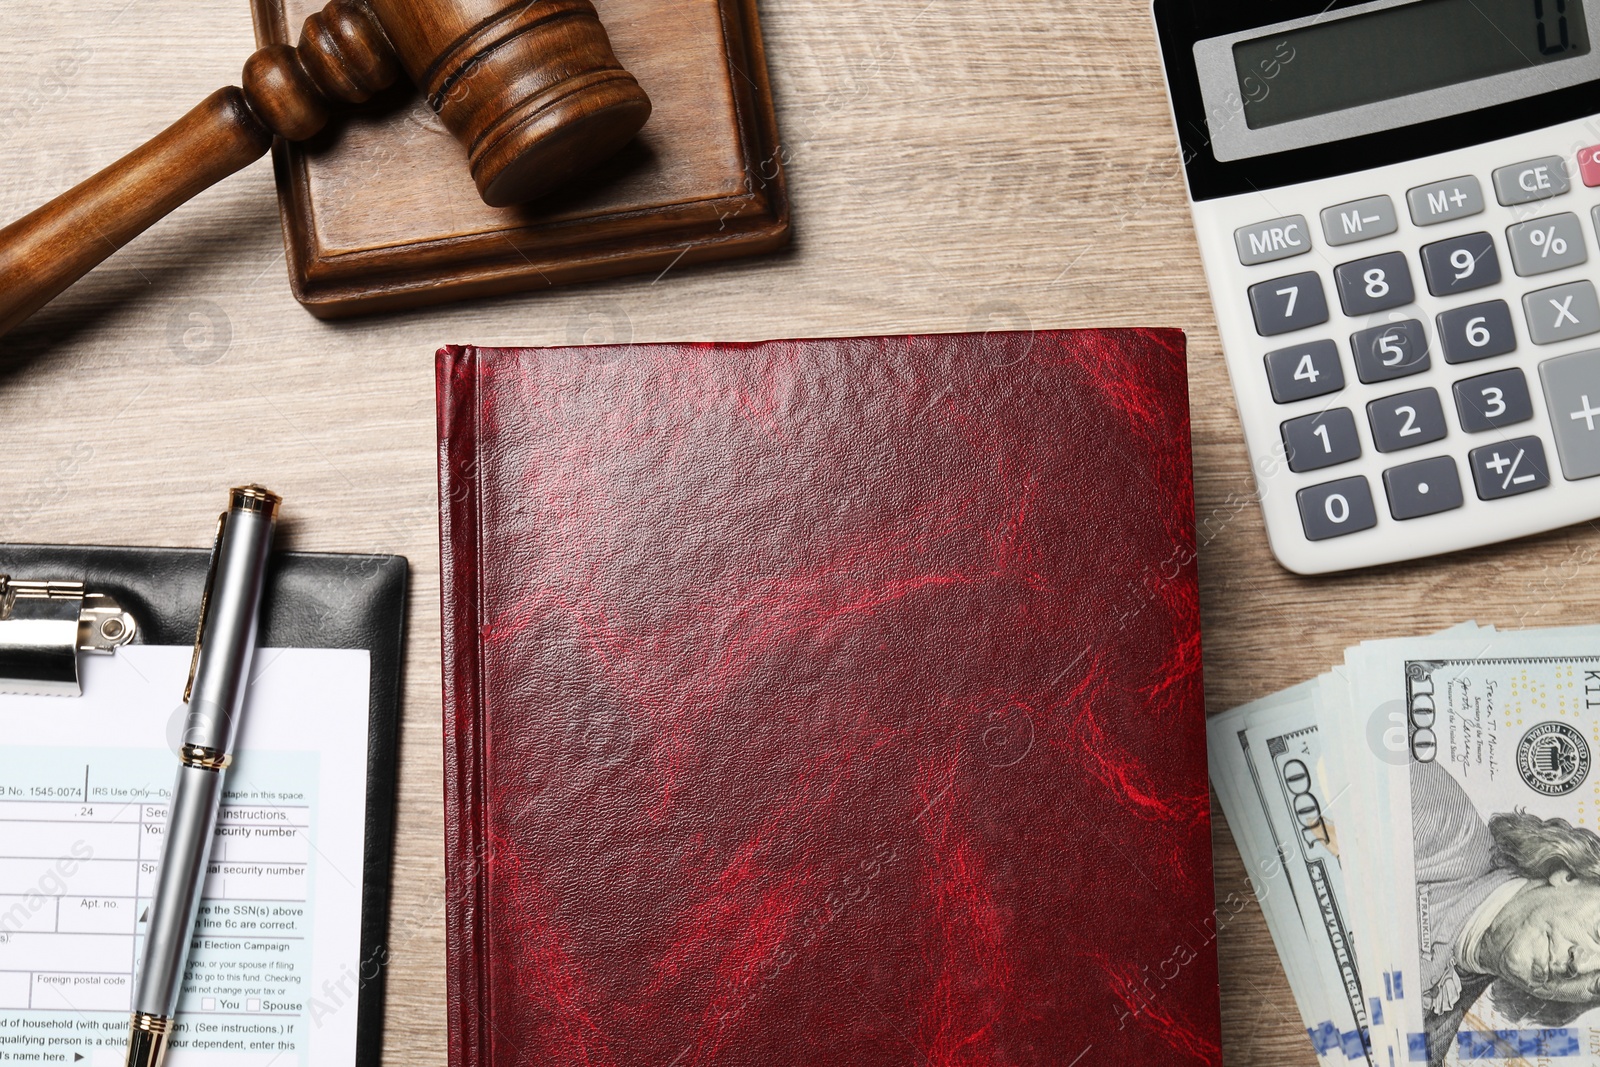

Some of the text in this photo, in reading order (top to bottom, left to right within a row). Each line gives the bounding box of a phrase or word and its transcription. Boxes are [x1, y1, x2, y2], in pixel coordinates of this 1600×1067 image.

[1518, 166, 1551, 192] CE
[1427, 188, 1468, 215] M+
[1249, 224, 1301, 256] MRC
[1530, 226, 1567, 258] %
[1450, 249, 1475, 280] 9
[1363, 268, 1390, 298] 8
[1276, 286, 1300, 318] 7
[1465, 316, 1491, 347] 6
[1379, 335, 1404, 367] 5
[1293, 354, 1320, 383] 4
[1480, 387, 1507, 418] 3
[1394, 405, 1422, 437] 2
[1313, 424, 1332, 454] 1
[1324, 493, 1350, 523] 0
[1410, 673, 1437, 763] 100
[1449, 725, 1457, 741] United
[1519, 725, 1563, 793] FEDERAL RESERVE SYSTEM
[1567, 730, 1587, 787] UNITED STATES
[8, 786, 25, 797] No.
[30, 787, 82, 797] 1545-0074
[92, 787, 108, 795] IRS
[111, 788, 128, 796] Use
[223, 790, 248, 800] staple
[261, 791, 275, 799] this
[80, 807, 93, 816] 24
[146, 807, 289, 820] See instructions.
[1283, 759, 1330, 849] 100
[144, 824, 297, 838] You ecurity number
[224, 865, 263, 876] security
[266, 866, 305, 876] number
[80, 899, 119, 909] Apt. no.
[214, 906, 230, 915] the
[233, 906, 270, 917] SSN(s)
[273, 907, 303, 916] above
[204, 919, 222, 928] line
[225, 920, 237, 929] 6c
[240, 921, 257, 929] are
[260, 920, 298, 930] correct.
[1310, 865, 1350, 967] DOLLARS
[1421, 897, 1430, 949] FRANKLIN
[204, 941, 241, 950] Election
[244, 942, 290, 952] Campaign
[190, 961, 207, 969] you,
[219, 962, 236, 970] your
[238, 962, 267, 971] spouse
[269, 961, 275, 969] if
[276, 961, 294, 971] filing
[37, 975, 126, 985] Foreign postal code
[243, 974, 261, 982] fund.
[264, 975, 302, 984] Checking
[213, 987, 242, 995] change
[220, 1000, 240, 1009] You
[263, 1001, 302, 1011] Spouse
[10, 1019, 20, 1027] of
[22, 1019, 73, 1028] household
[76, 1020, 99, 1030] (with
[102, 1021, 130, 1031] qualif
[195, 1023, 218, 1033] (See
[221, 1024, 284, 1034] instructions.)
[287, 1025, 294, 1033] If
[0, 1036, 45, 1046] qualifying
[48, 1037, 82, 1046] person
[85, 1037, 93, 1045] is
[105, 1037, 128, 1046] child
[168, 1040, 188, 1049] your
[192, 1039, 246, 1050] dependent,
[249, 1041, 275, 1050] enter
[277, 1041, 295, 1050] this
[13, 1053, 40, 1061] name
[43, 1052, 67, 1061] here.
